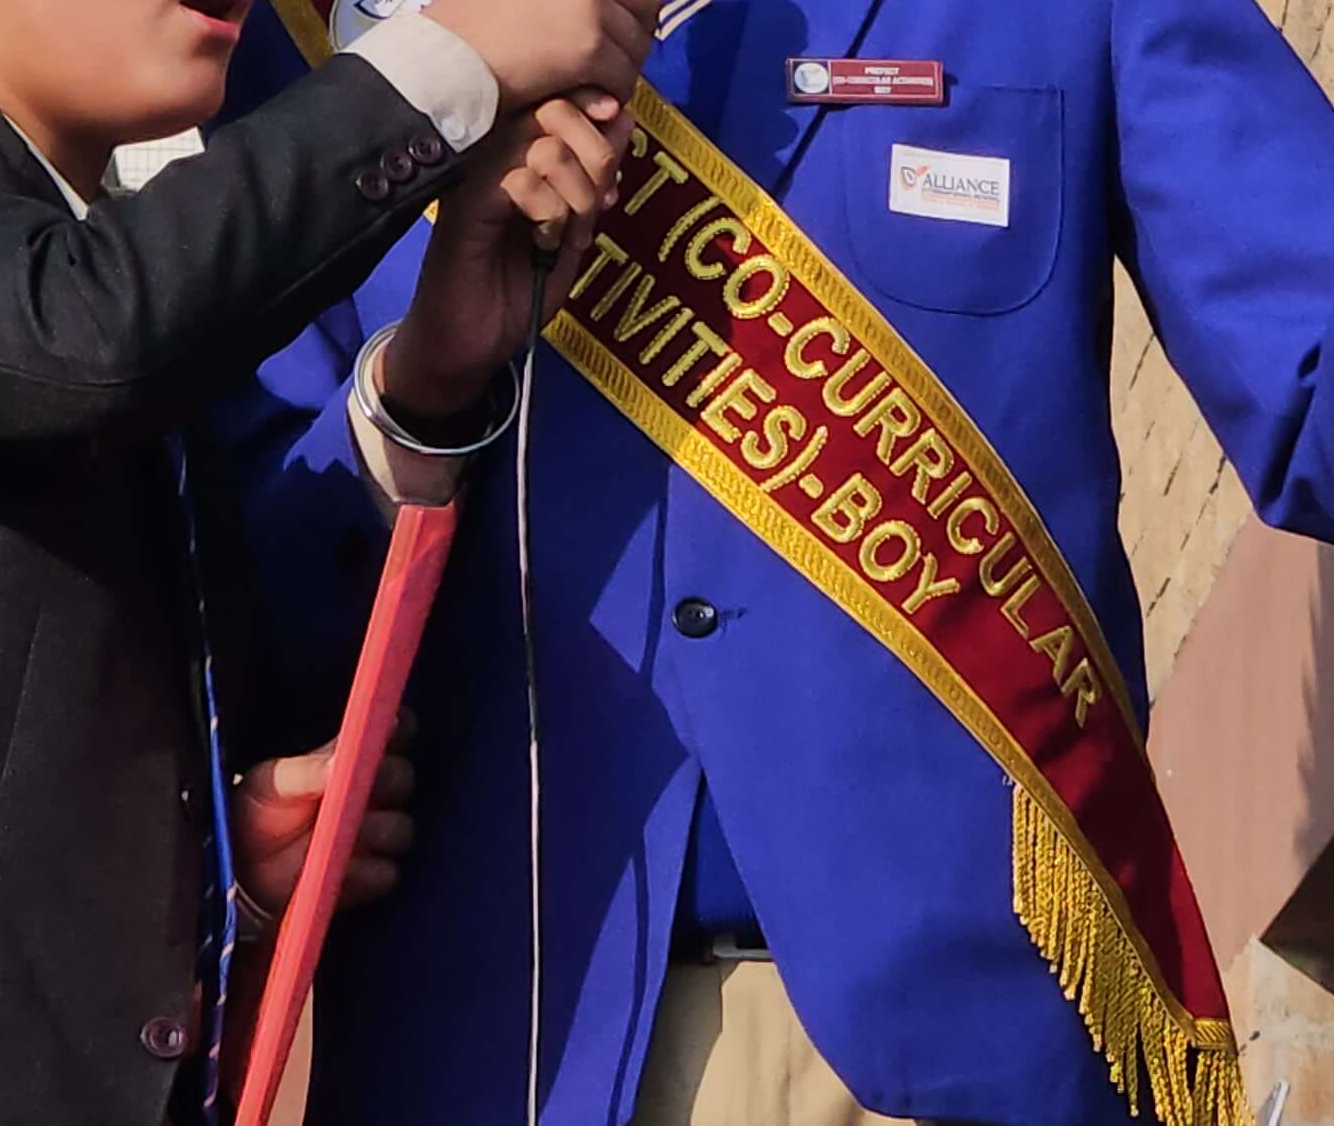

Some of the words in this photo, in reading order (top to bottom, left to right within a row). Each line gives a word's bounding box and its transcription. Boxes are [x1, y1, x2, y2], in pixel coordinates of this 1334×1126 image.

[922, 172, 1001, 196] ALLIANCE
[568, 231, 961, 614] TIVITIES)-BOY
[657, 195, 1103, 729] (CO-CURRICULAR
